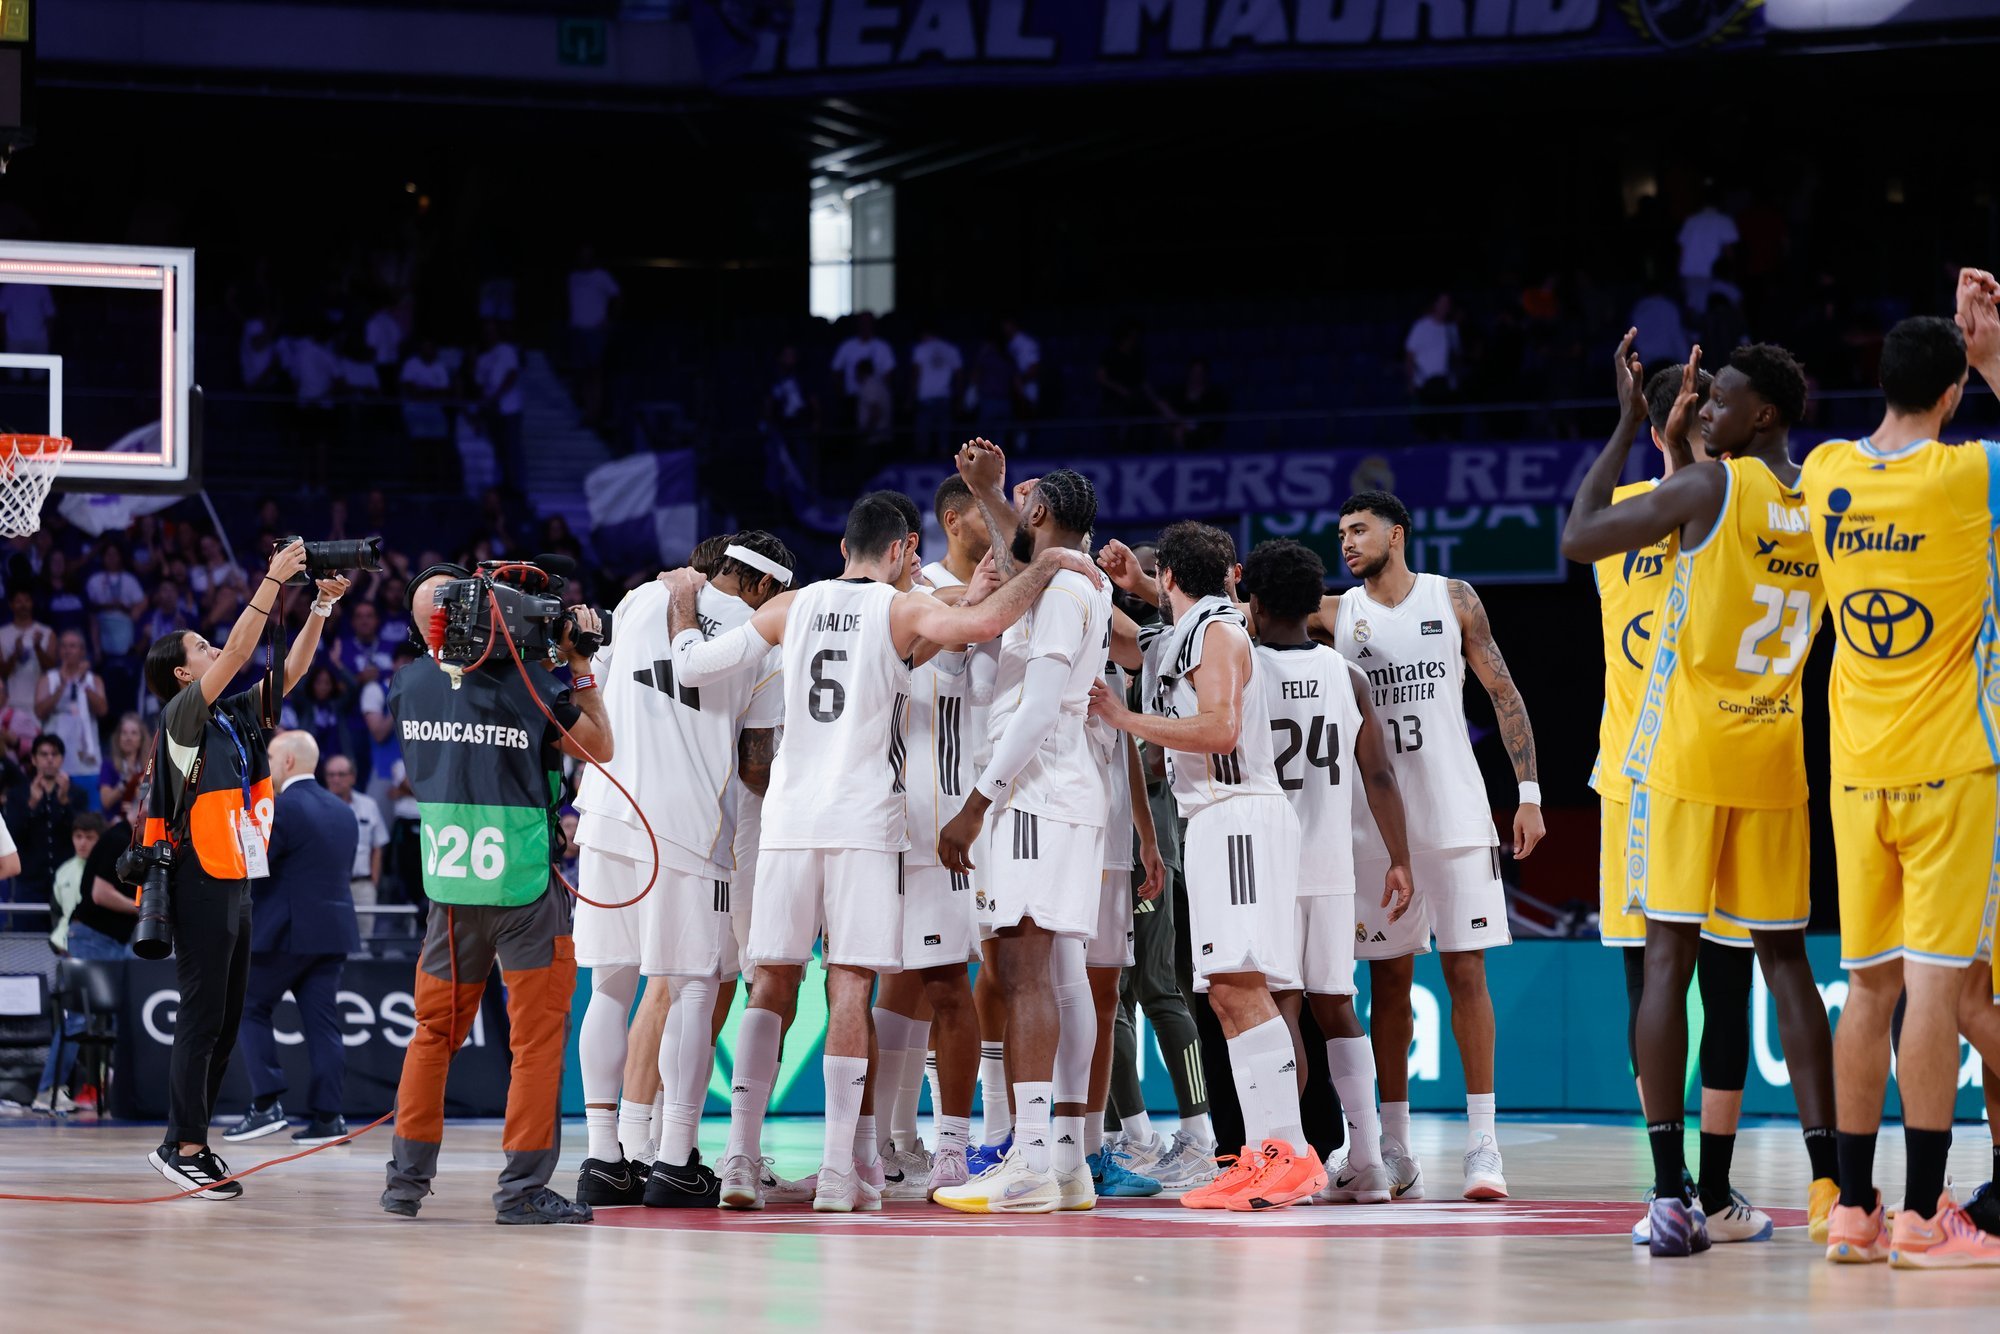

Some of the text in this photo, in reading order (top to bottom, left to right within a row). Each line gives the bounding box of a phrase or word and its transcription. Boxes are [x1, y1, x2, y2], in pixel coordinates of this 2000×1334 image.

[812, 612, 863, 633] AALDE
[1735, 583, 1812, 676] 23
[808, 648, 848, 723] 6
[1366, 660, 1446, 688] mirates
[1281, 679, 1320, 700] FELIZ
[1371, 682, 1435, 707] LY BETTER
[402, 719, 530, 750] BROADCASTERS
[1387, 714, 1423, 754] 13
[1269, 715, 1341, 791] 24
[190, 757, 202, 784] Canon
